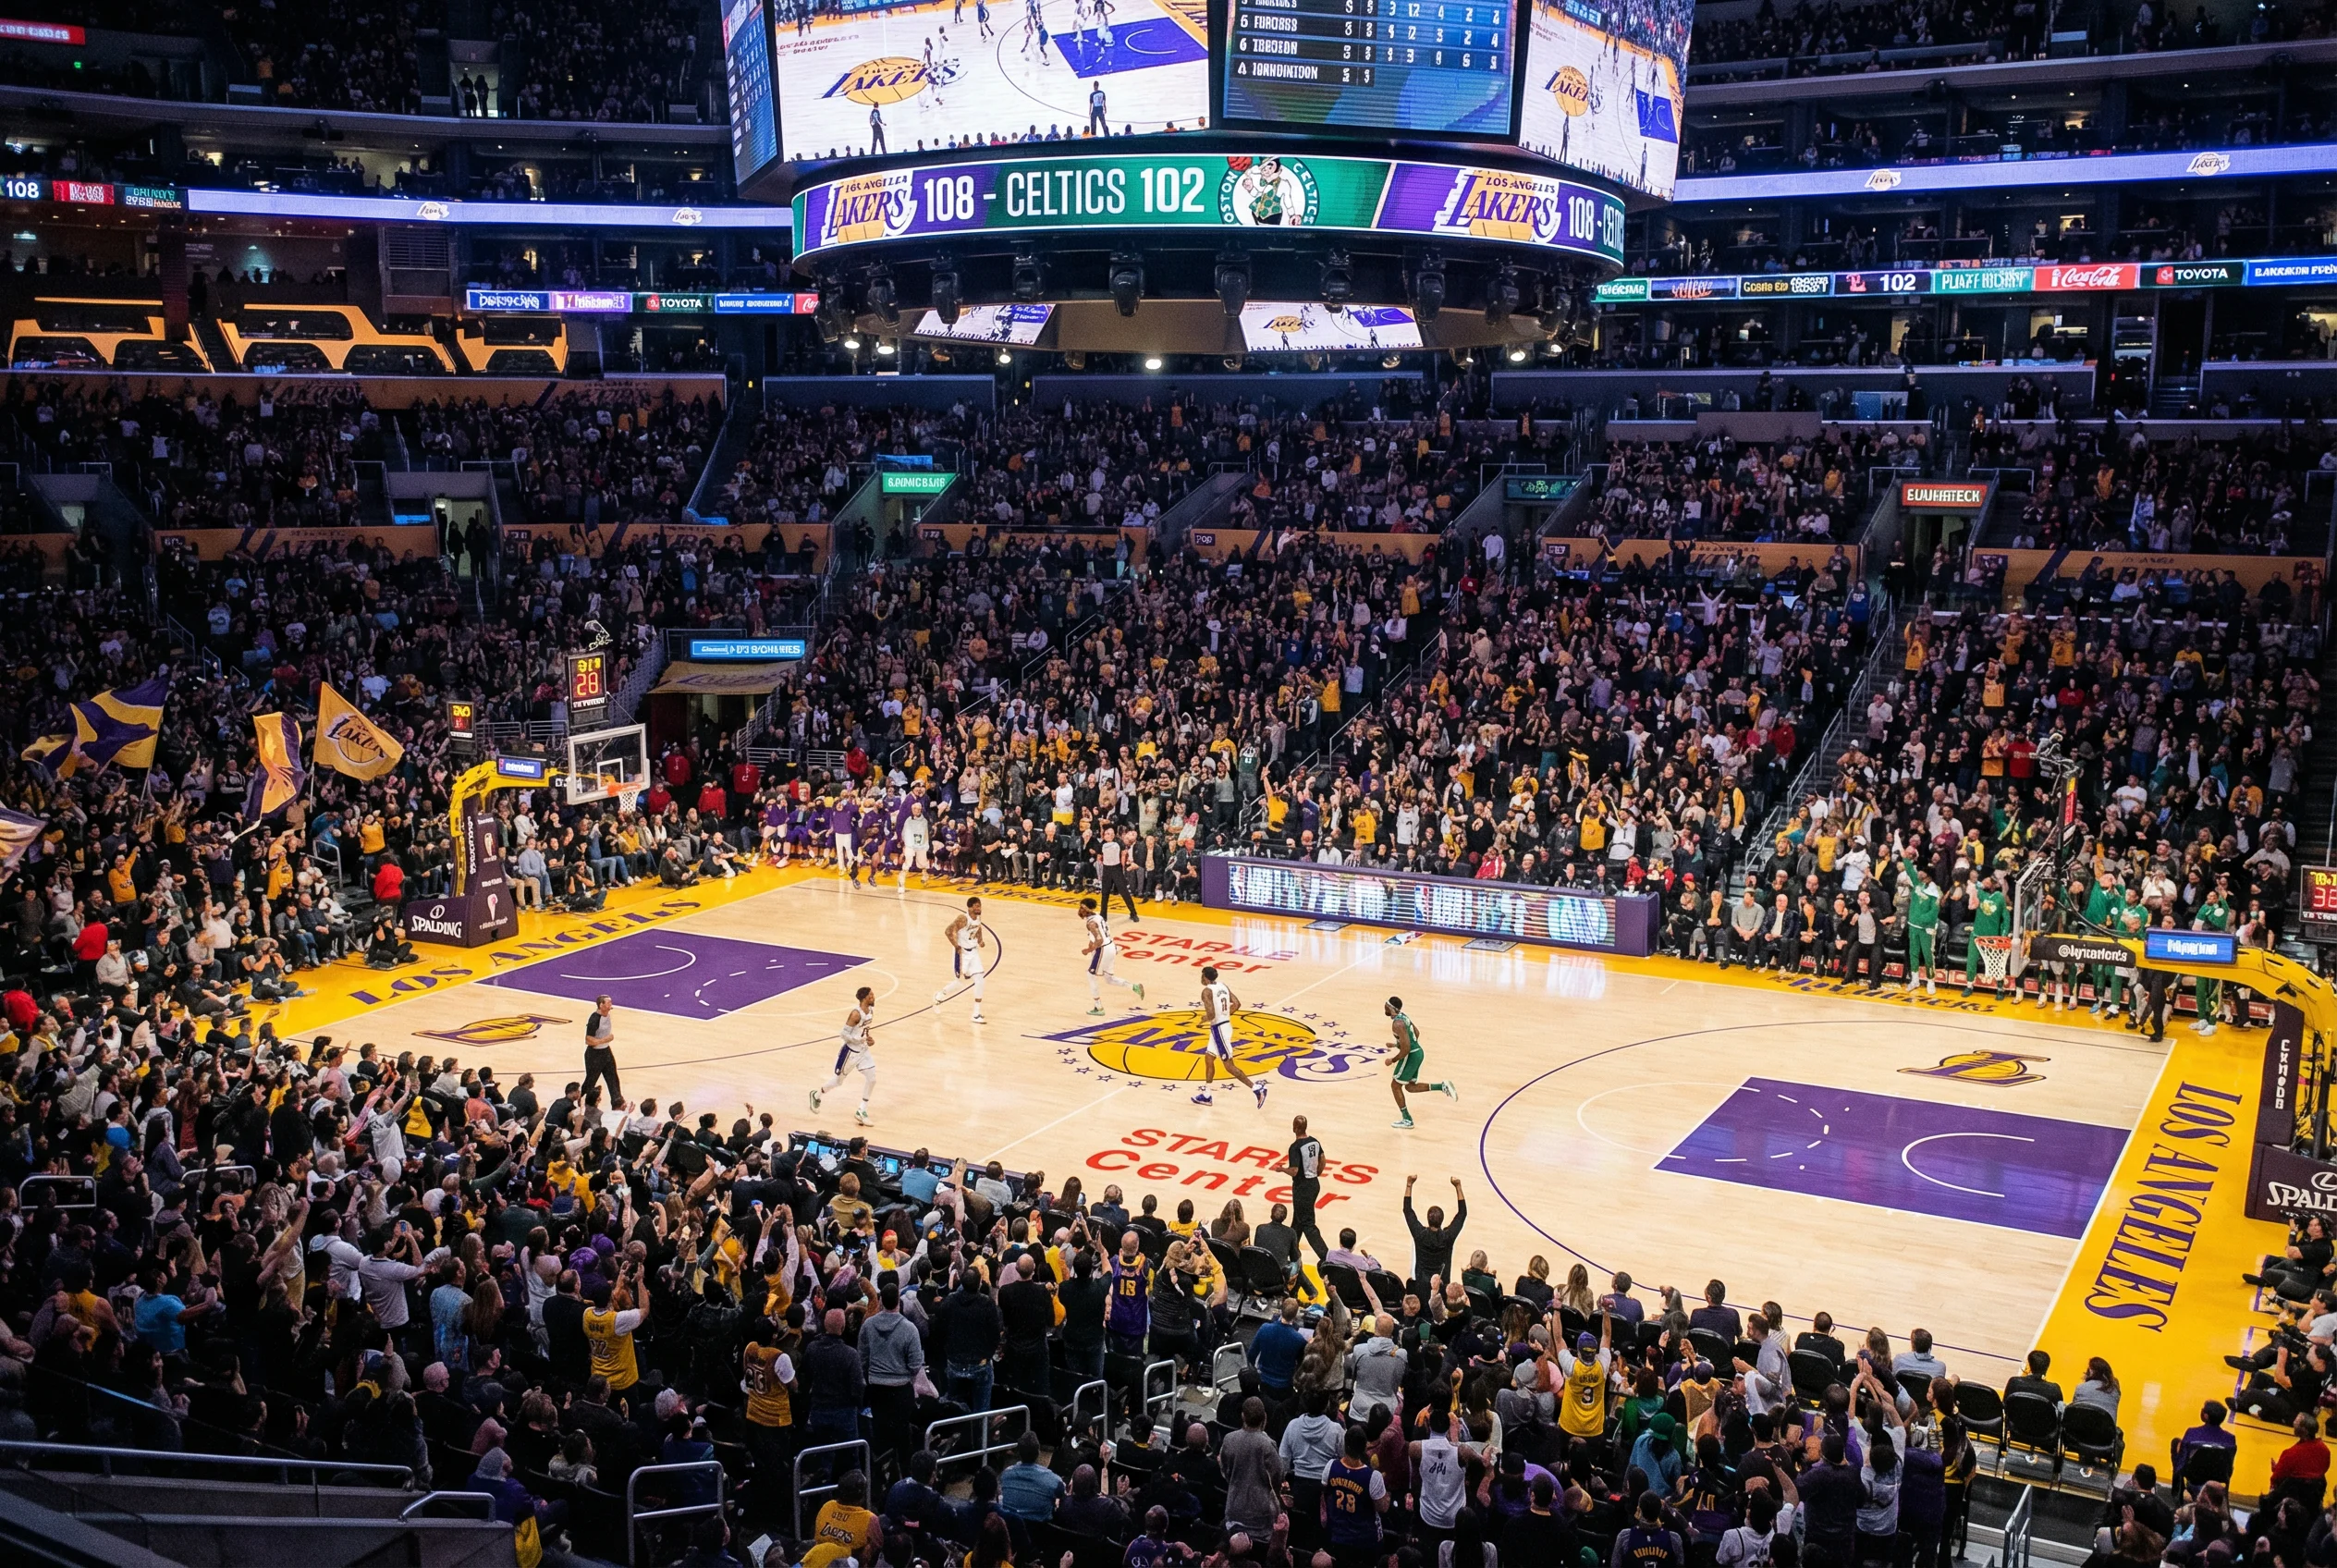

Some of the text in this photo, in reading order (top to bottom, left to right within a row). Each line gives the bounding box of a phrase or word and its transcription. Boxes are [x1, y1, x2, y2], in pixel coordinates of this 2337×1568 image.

[6, 180, 40, 199] 108
[924, 175, 975, 223] 108
[1006, 168, 1127, 217] CELTICS
[1140, 166, 1205, 214] 102
[1486, 177, 1508, 188] LOS
[826, 184, 912, 239] LAKERS
[1440, 174, 1560, 239] LAKERS
[1567, 195, 1596, 241] 108
[1878, 273, 1916, 292] 102
[2174, 267, 2229, 280] TOYOTA
[660, 298, 703, 309] TOYOTA
[576, 671, 599, 696] 28
[410, 914, 462, 938] SPALDING
[347, 963, 473, 1007] LOS
[2160, 1080, 2244, 1148] LOS
[1084, 1149, 1352, 1210] Center
[2084, 1143, 2220, 1333] ANGELES
